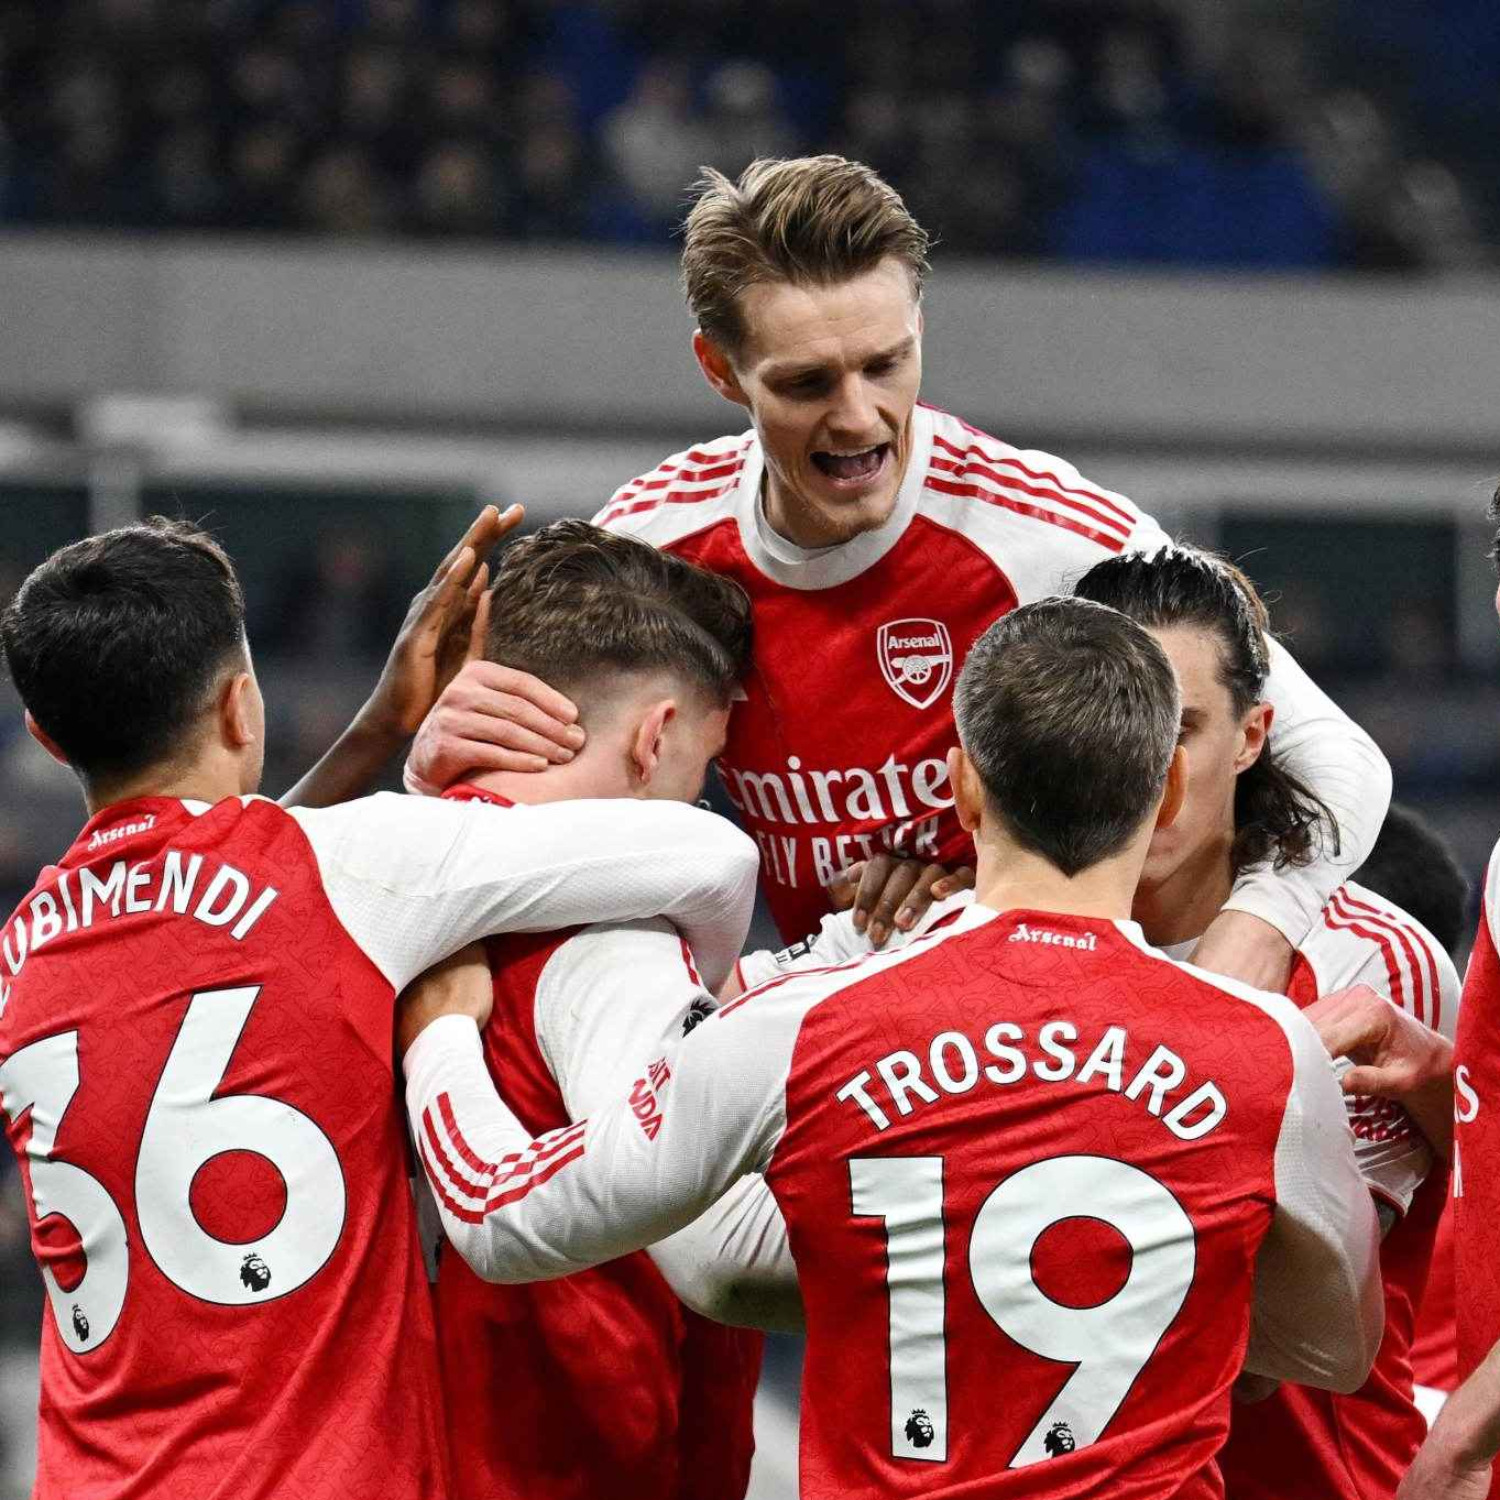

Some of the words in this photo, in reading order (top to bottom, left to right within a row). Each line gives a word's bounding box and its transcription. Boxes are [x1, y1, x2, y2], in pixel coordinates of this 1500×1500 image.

[888, 633, 941, 649] Arsenal
[87, 813, 156, 851] Arsenal
[718, 754, 955, 825] mirate
[0, 850, 279, 1020] UBIMENDI
[1008, 922, 1097, 951] Arsenal
[836, 1021, 1228, 1141] TROSSARD
[0, 985, 347, 1355] 36
[848, 1154, 1196, 1469] 19
